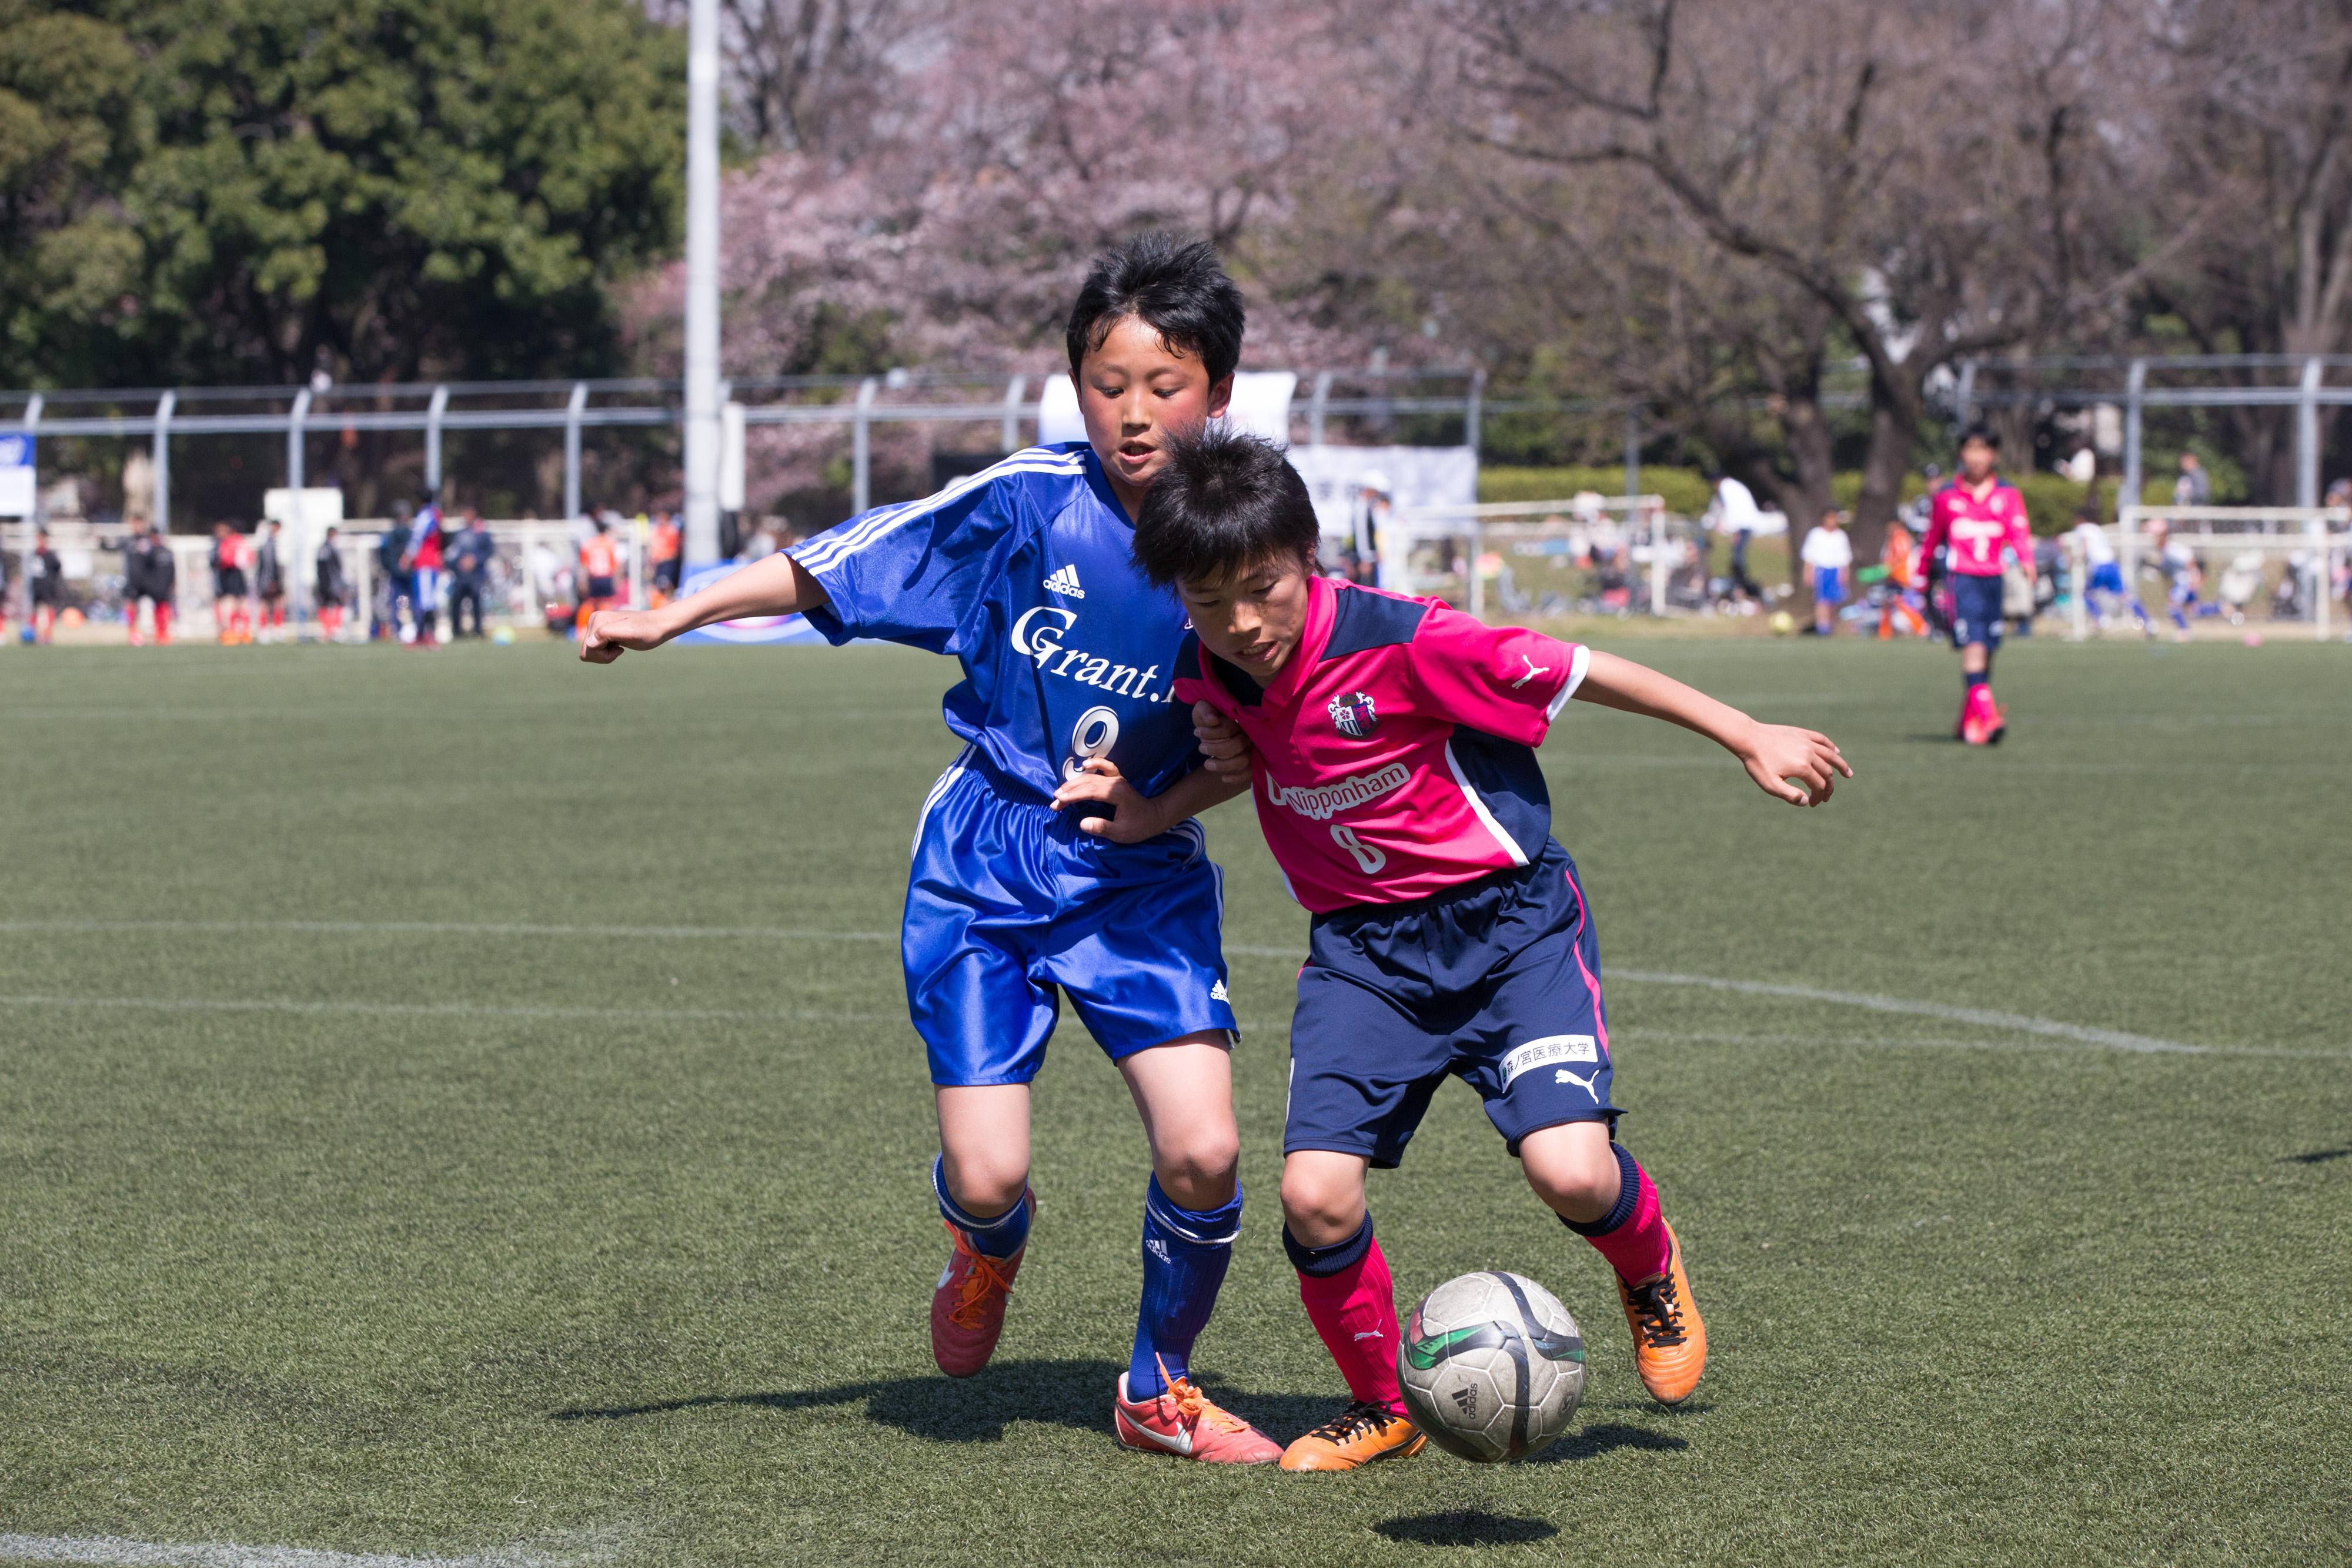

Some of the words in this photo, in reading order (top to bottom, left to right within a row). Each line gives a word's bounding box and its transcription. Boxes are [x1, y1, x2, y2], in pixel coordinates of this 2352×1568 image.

[1043, 579, 1085, 599] adidas
[1062, 705, 1120, 782] 9
[1287, 767, 1405, 815] Nipponham
[1330, 824, 1387, 874] 8
[1506, 1042, 1590, 1075] 森ノ宮医療大学
[1146, 1239, 1171, 1264] adidas
[1467, 1383, 1478, 1419] adidas
